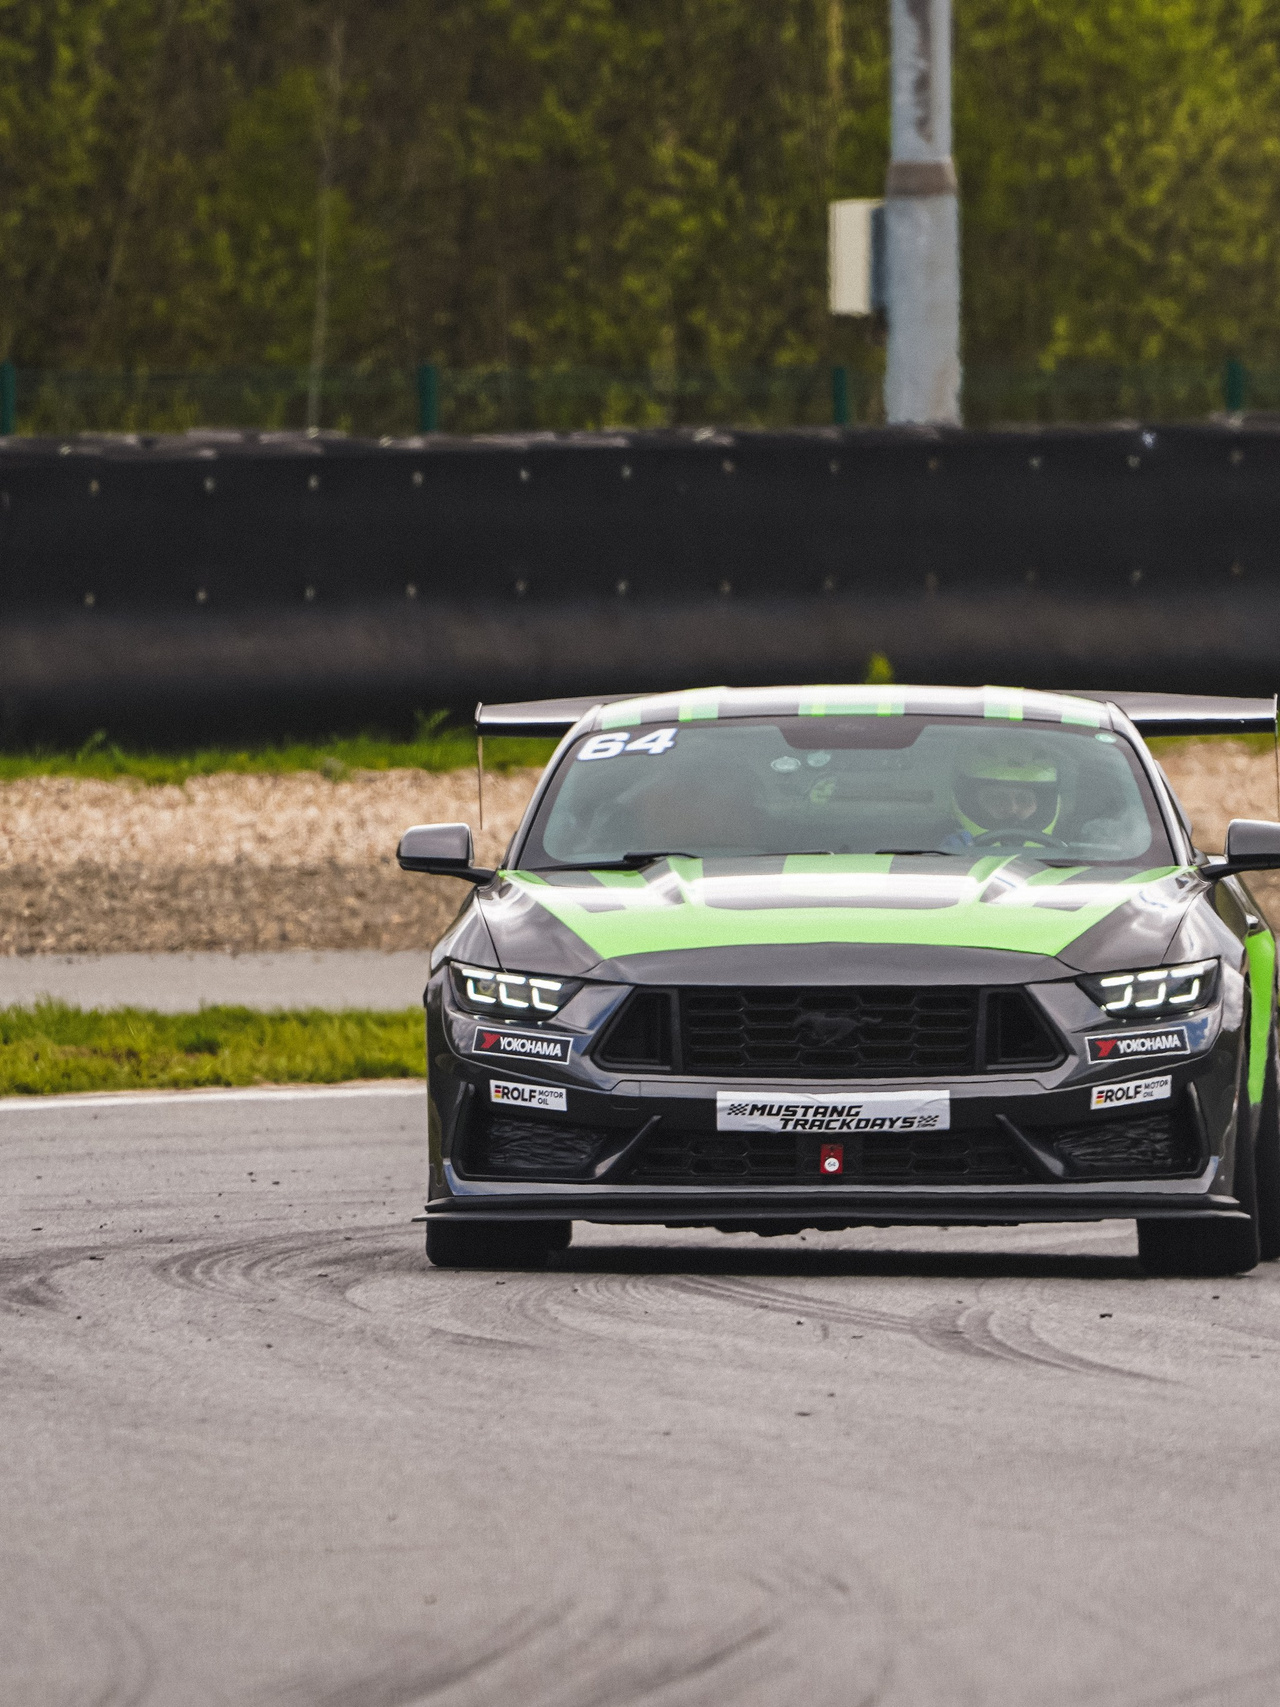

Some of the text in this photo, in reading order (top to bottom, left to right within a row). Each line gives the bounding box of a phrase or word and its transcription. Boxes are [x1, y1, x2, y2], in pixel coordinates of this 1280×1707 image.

[577, 727, 678, 761] 64
[500, 1036, 562, 1057] YOKOHAMA
[1117, 1034, 1181, 1054] YOKOHAMA
[502, 1086, 537, 1103] ROLF
[538, 1089, 564, 1099] MOTOR
[538, 1097, 550, 1106] OIL
[1104, 1084, 1142, 1104] ROLF
[748, 1104, 863, 1118] MUSTANG
[780, 1116, 918, 1131] TRACKDAYS
